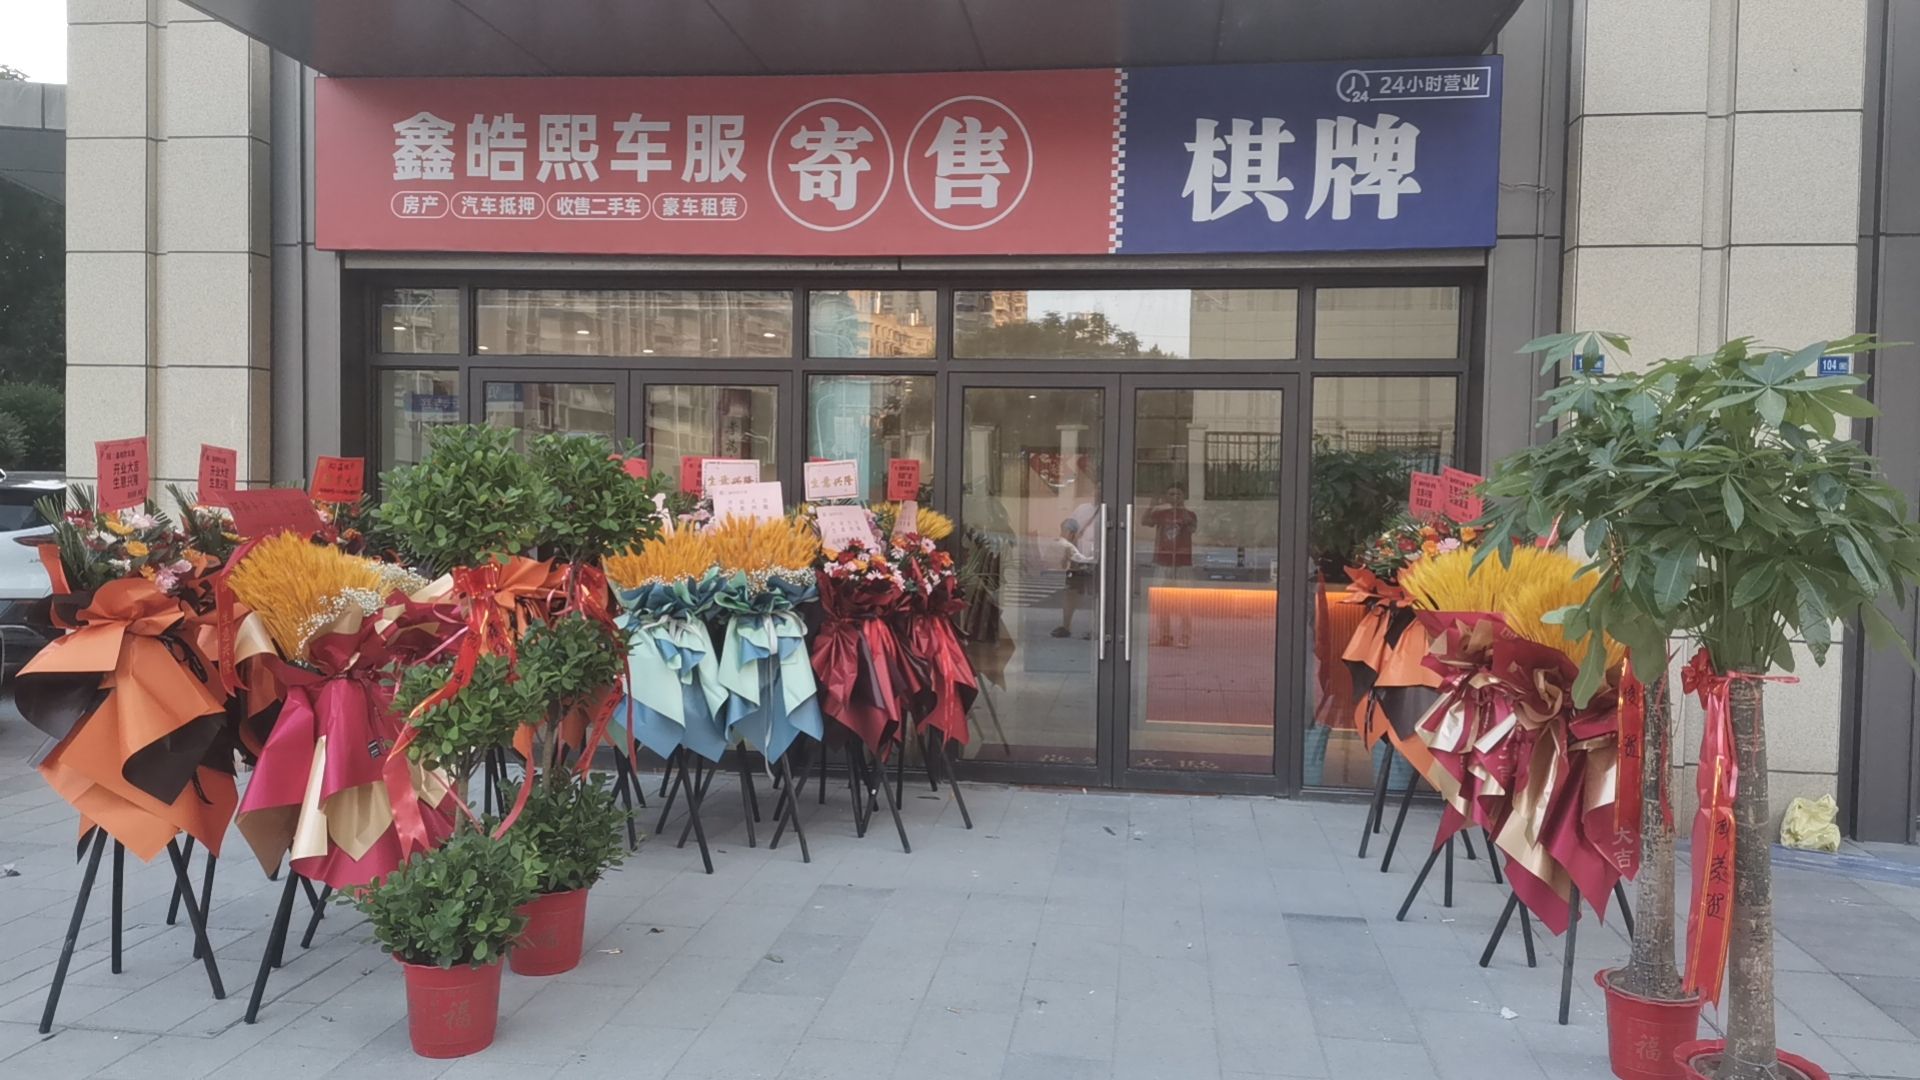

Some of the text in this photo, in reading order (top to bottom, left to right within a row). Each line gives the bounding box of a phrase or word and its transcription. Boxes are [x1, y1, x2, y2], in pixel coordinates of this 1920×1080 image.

[1380, 74, 1480, 94] 24小时营业
[1352, 90, 1369, 103] 24
[392, 111, 747, 184] 鑫皓熙车服
[788, 116, 1010, 211] 寄售
[1181, 113, 1422, 223] 棋牌
[402, 195, 738, 217] 房产 汽车抵押 收售二手车 豪车租赁
[1823, 359, 1837, 370] 104
[113, 461, 139, 476] 开业大吉
[1611, 825, 1634, 869] 大吉
